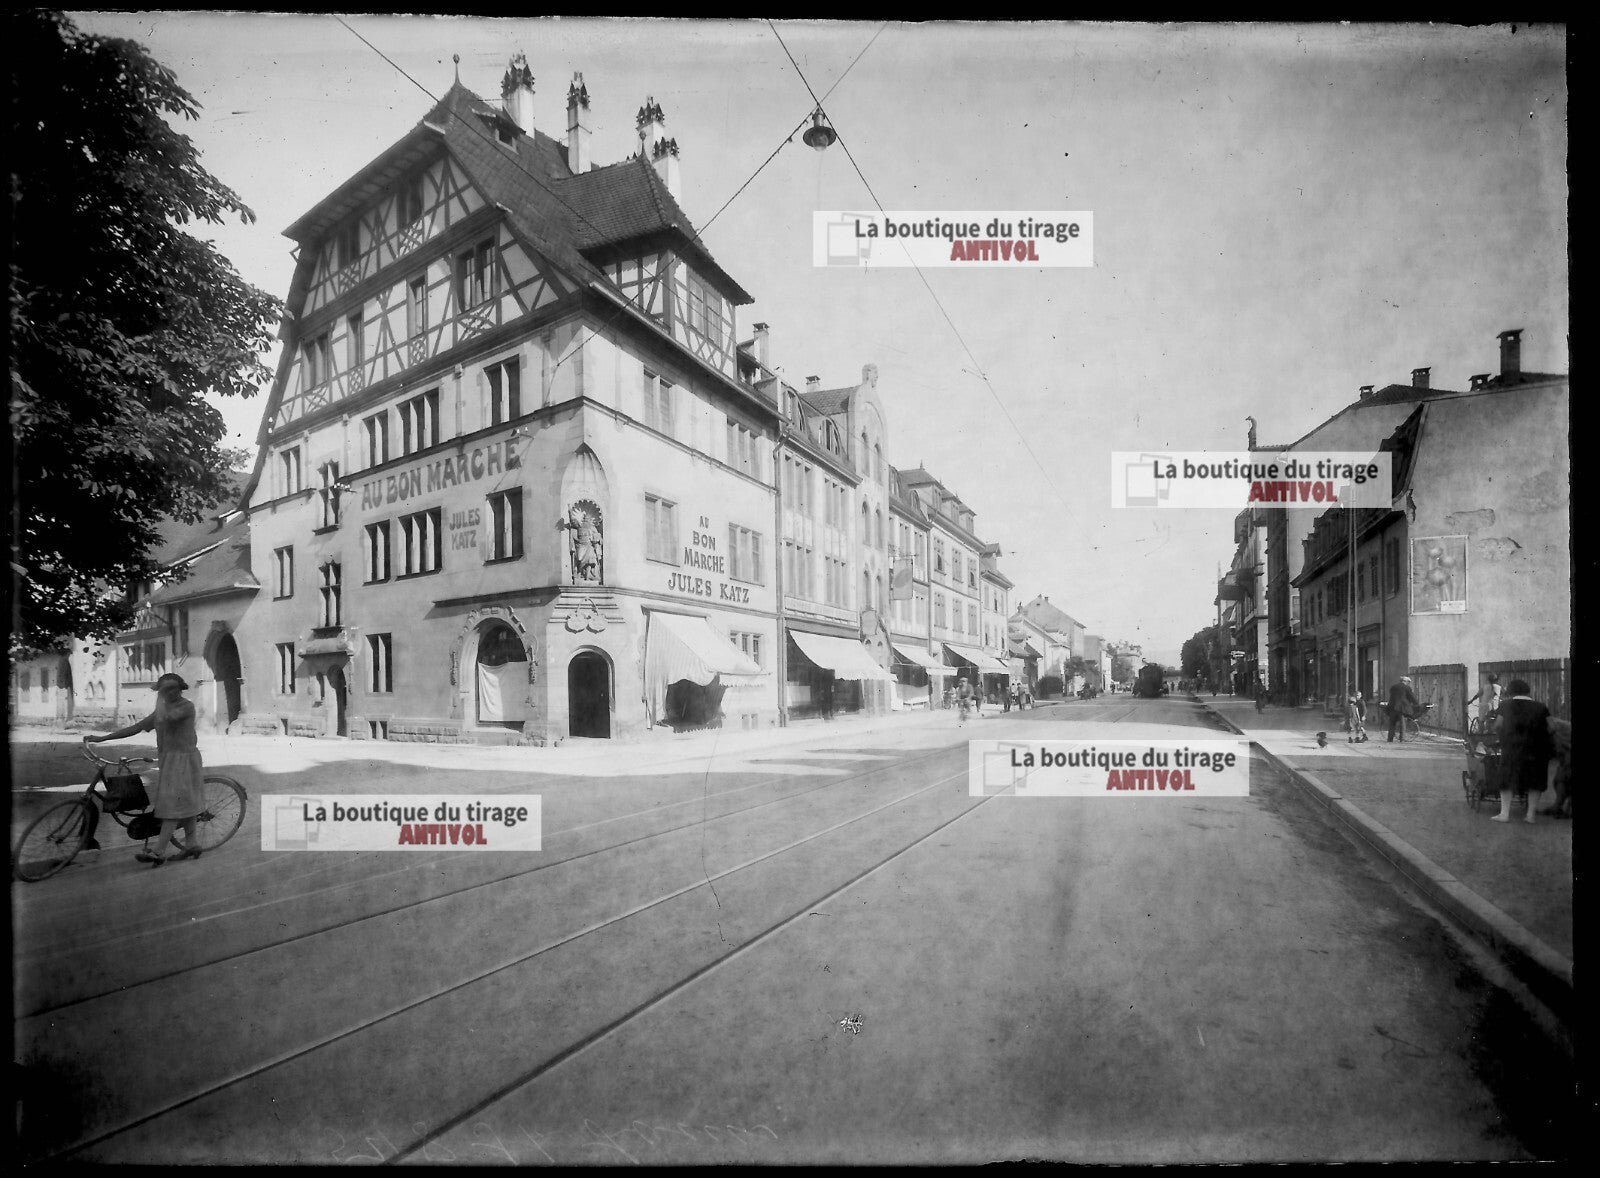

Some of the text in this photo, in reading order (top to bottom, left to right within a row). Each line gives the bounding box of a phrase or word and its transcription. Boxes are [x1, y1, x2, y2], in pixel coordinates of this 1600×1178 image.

[361, 479, 383, 511] AU
[386, 468, 422, 504] BON
[449, 507, 480, 531] JULES
[699, 515, 710, 529] AU
[451, 529, 477, 550] KATZ
[692, 530, 716, 551] BON
[684, 546, 725, 574] MARCHE
[668, 572, 750, 604] JULES KATZ
